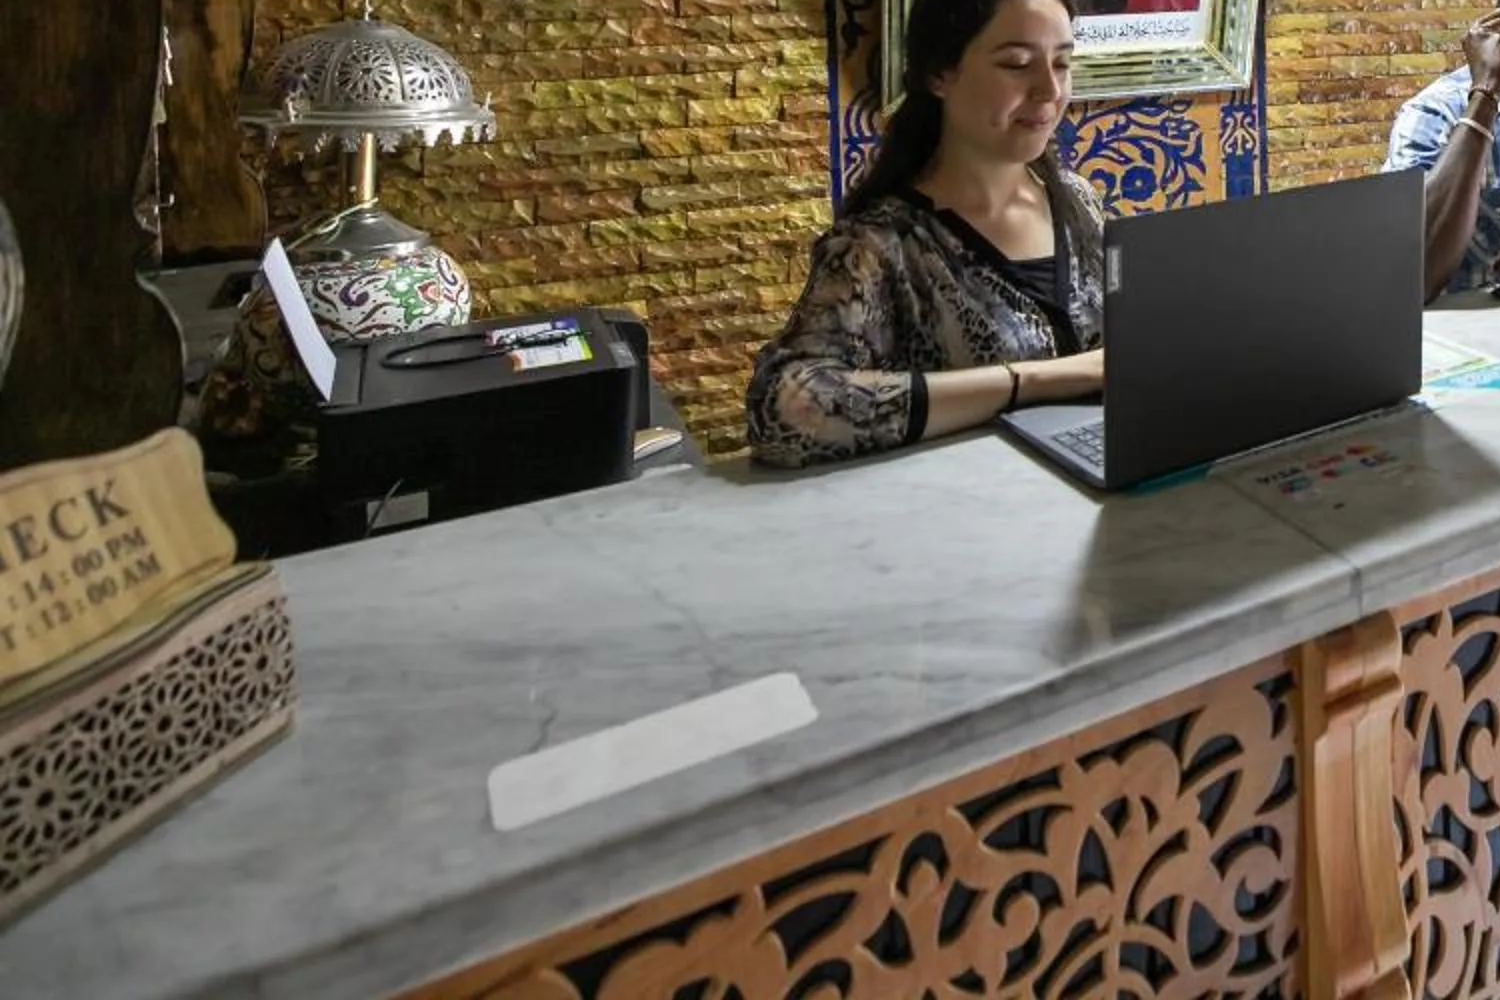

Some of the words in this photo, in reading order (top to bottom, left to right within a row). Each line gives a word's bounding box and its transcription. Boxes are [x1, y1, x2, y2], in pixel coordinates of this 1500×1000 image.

[0, 478, 131, 574] ECK
[105, 525, 147, 562] PM
[122, 551, 161, 590] AM
